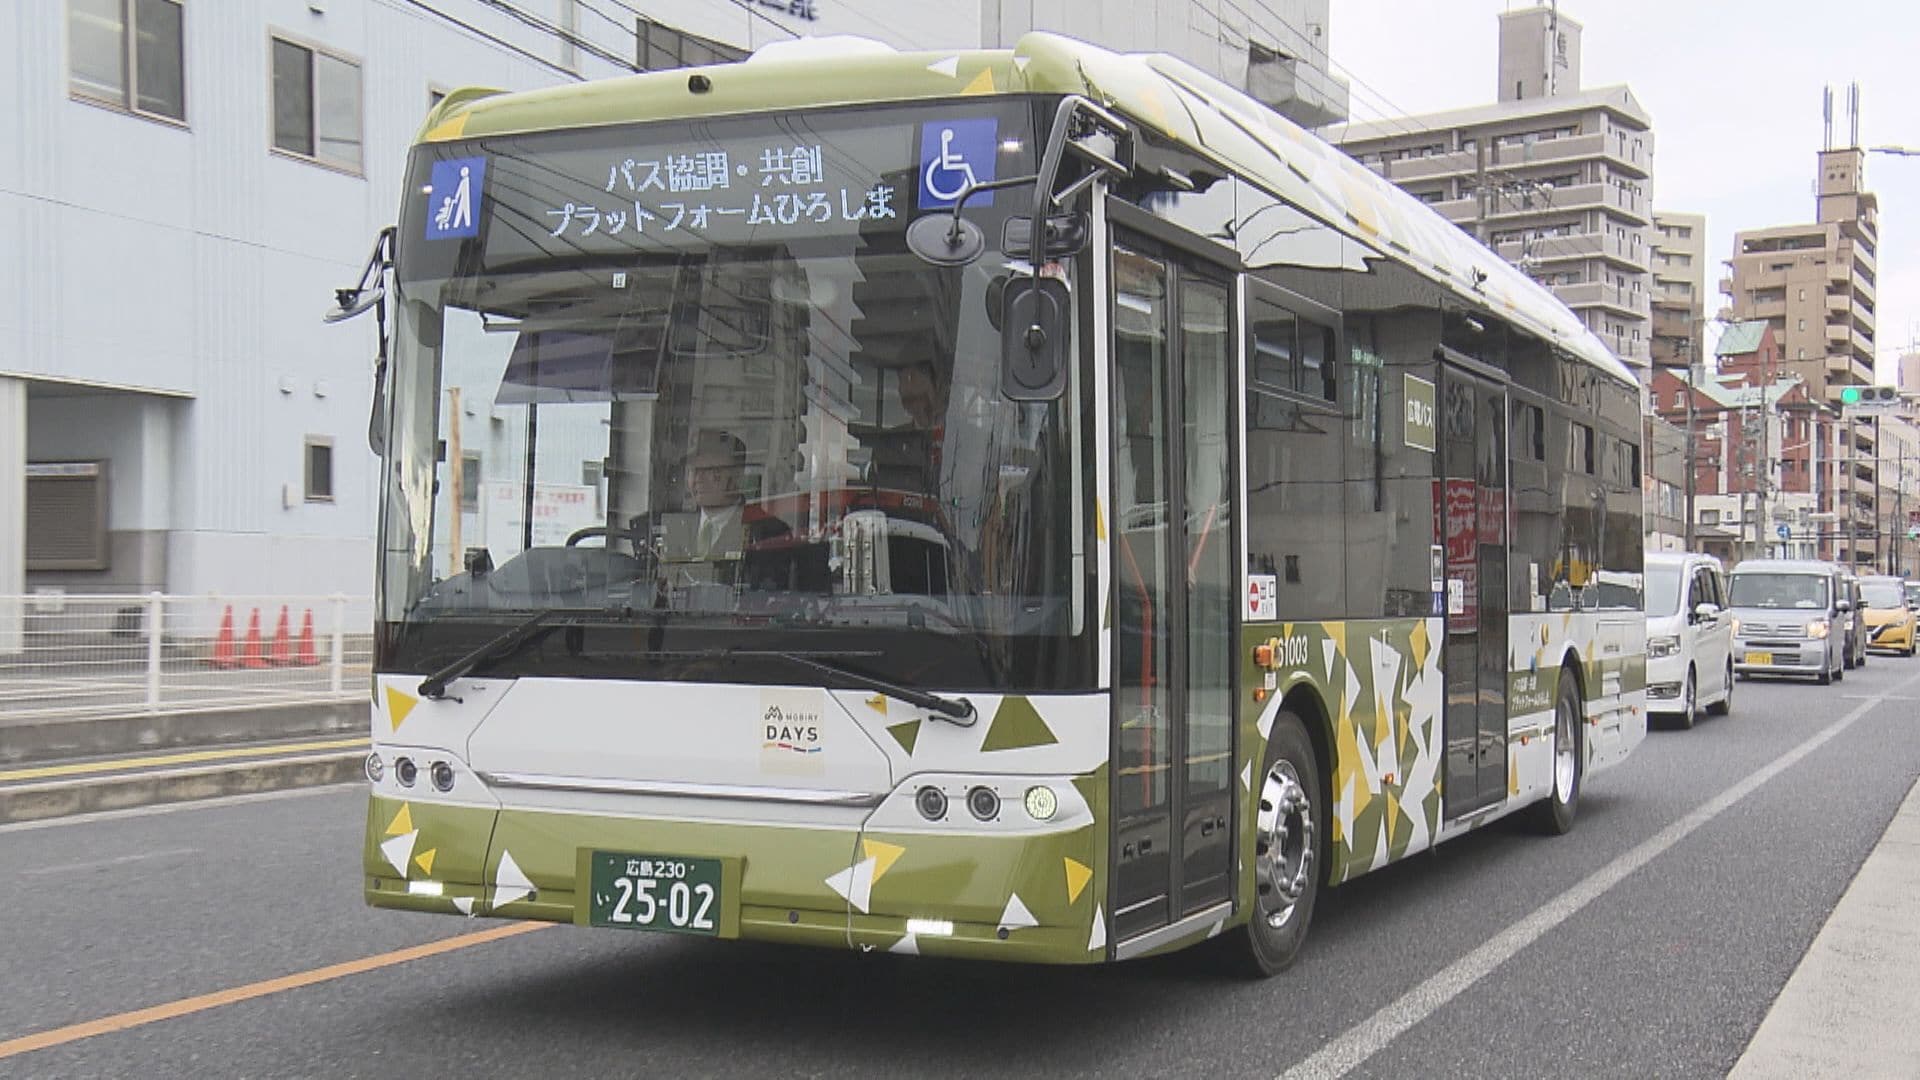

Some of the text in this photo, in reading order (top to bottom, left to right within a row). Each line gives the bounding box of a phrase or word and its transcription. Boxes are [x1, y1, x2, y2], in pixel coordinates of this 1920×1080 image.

[546, 183, 896, 237] プラットフォームひろしま
[766, 725, 818, 742] DAYS
[612, 877, 714, 929] 25-02
